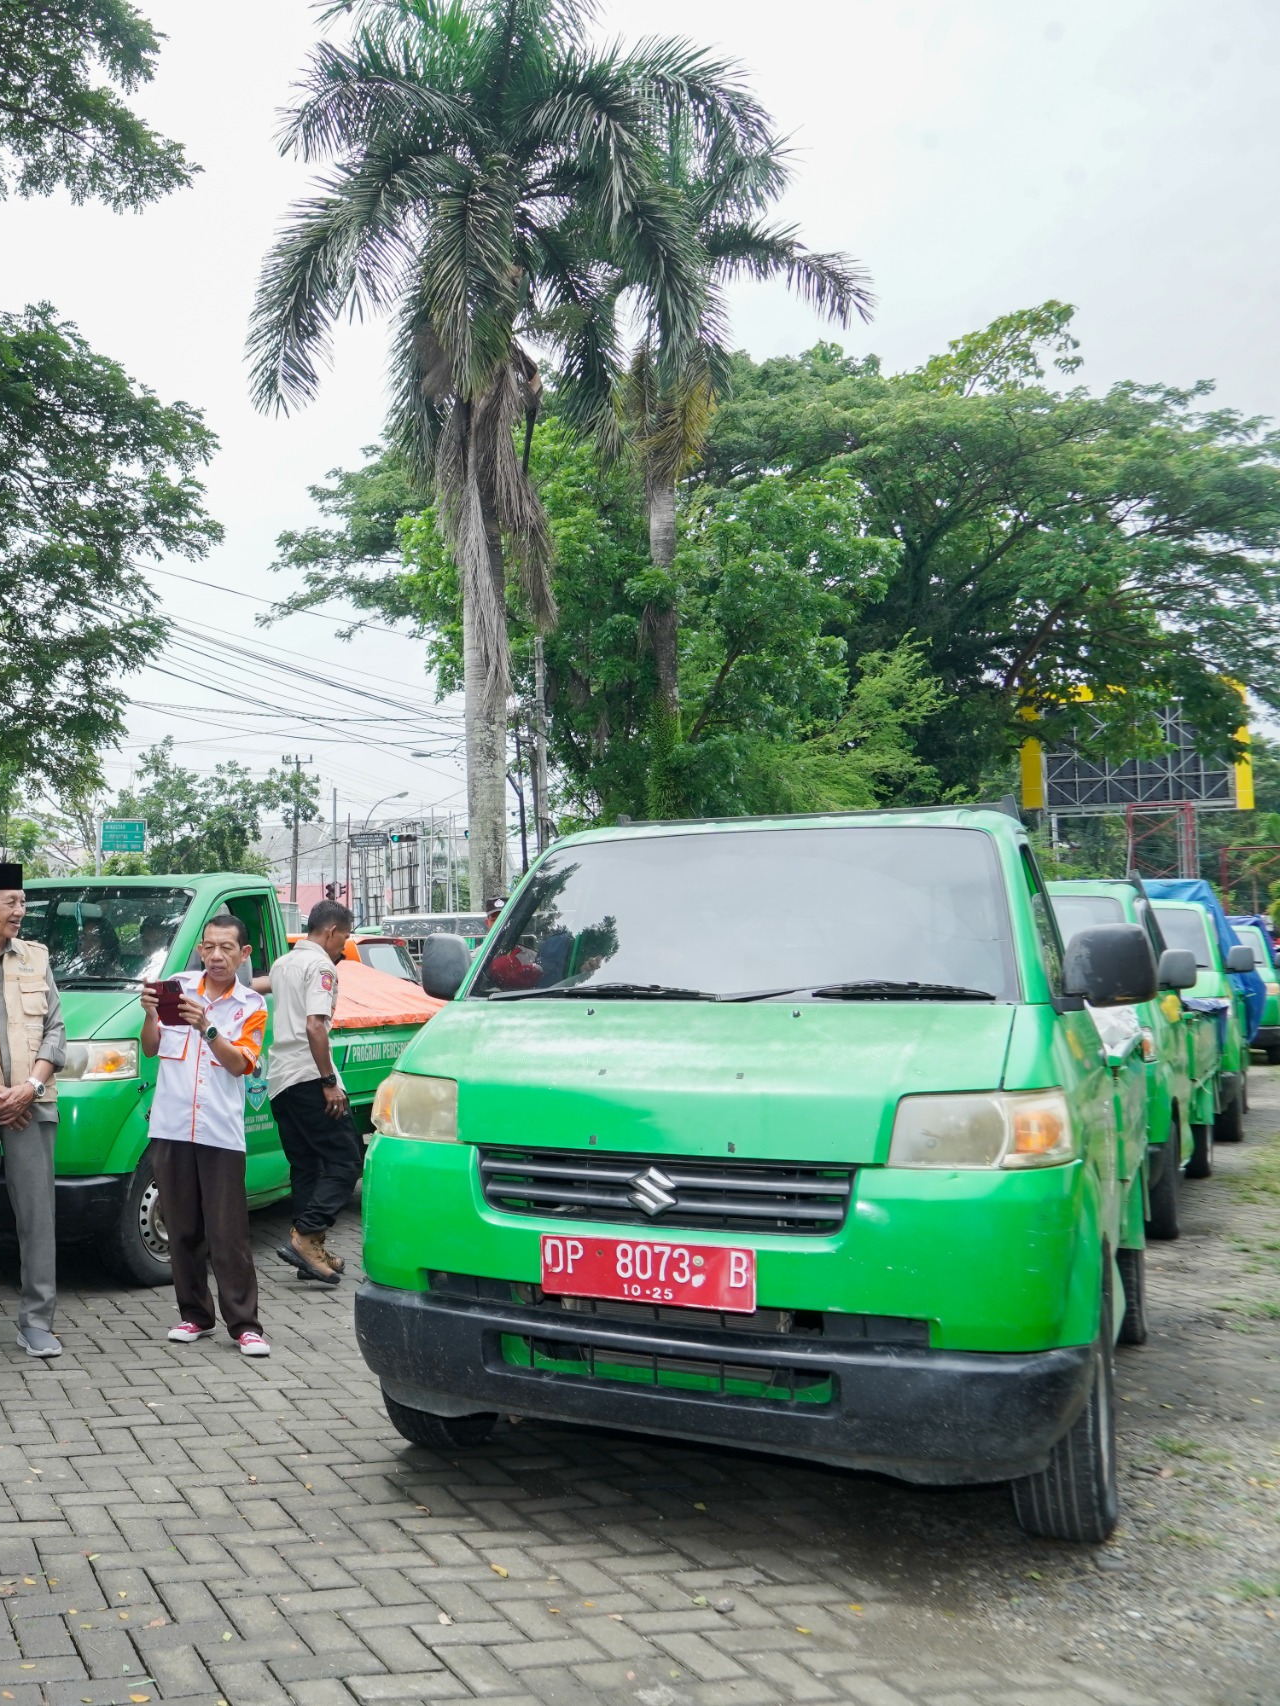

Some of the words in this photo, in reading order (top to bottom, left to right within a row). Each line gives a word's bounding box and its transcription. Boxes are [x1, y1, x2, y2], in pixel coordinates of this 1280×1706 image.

[352, 1043, 382, 1063] PROGRAM
[544, 1239, 584, 1274] DP
[615, 1243, 691, 1284] 8073
[729, 1251, 748, 1288] B
